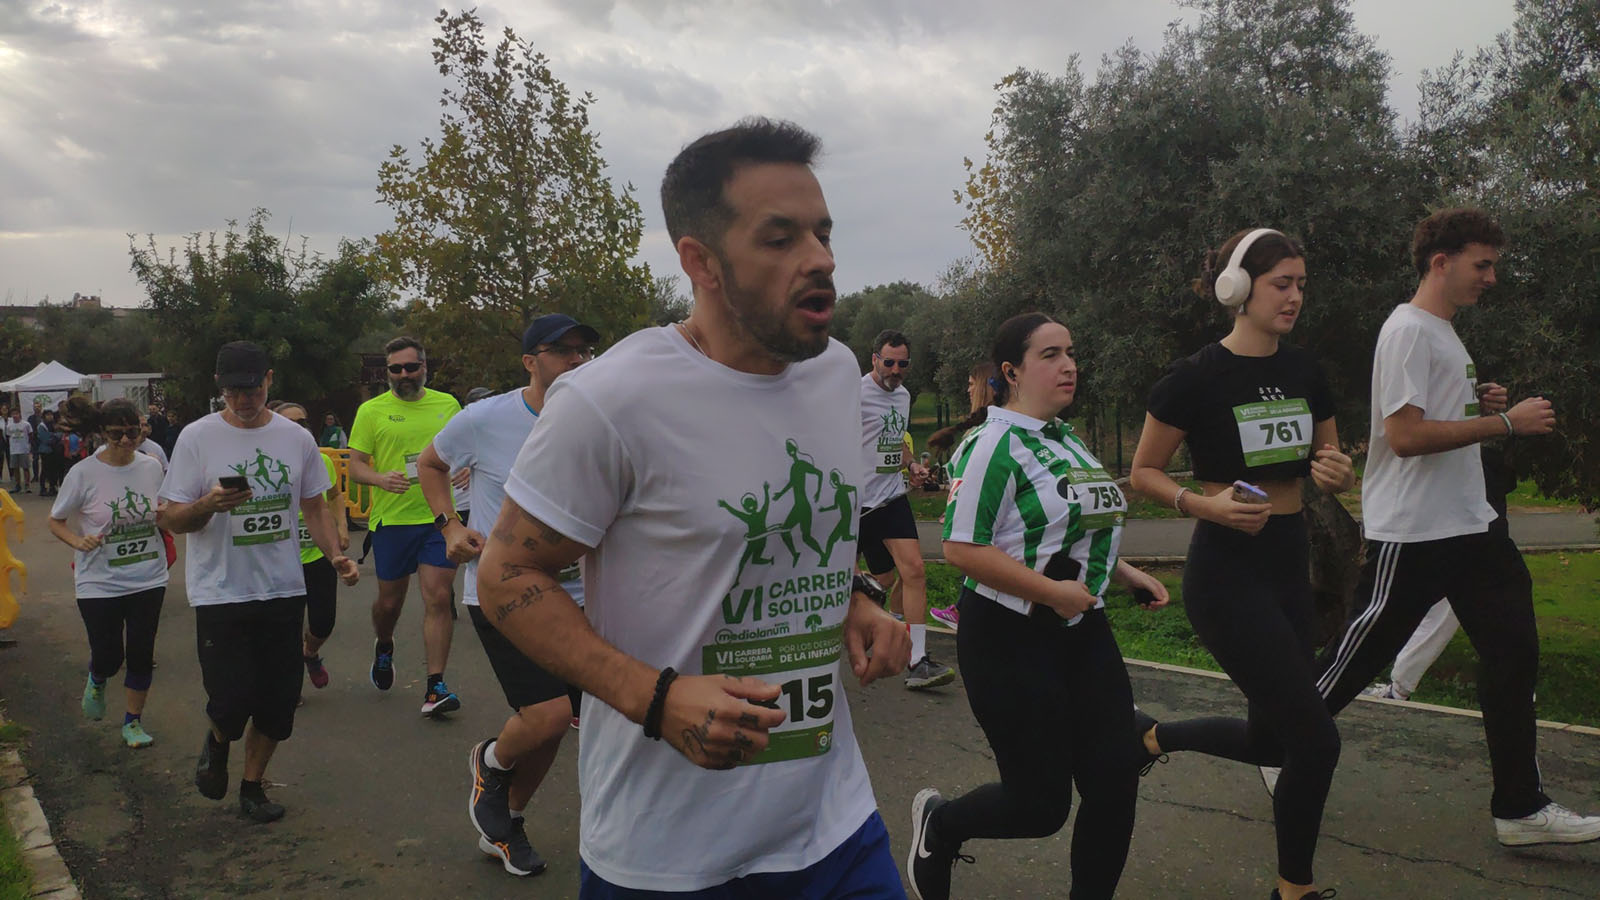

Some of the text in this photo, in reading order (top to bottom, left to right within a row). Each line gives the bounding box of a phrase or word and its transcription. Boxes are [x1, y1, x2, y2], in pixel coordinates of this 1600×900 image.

[1259, 420, 1303, 445] 761
[884, 454, 901, 465] 835
[1088, 486, 1122, 510] 758
[243, 515, 282, 533] 629
[117, 540, 148, 556] 627
[722, 585, 763, 624] VI
[715, 624, 790, 645] mediolanum
[716, 647, 772, 664] VI CARRERA
[779, 644, 796, 653] POR
[797, 642, 812, 651] LOS
[735, 654, 773, 664] SOLIDARIA
[780, 653, 793, 664] DE
[794, 651, 807, 661] LA
